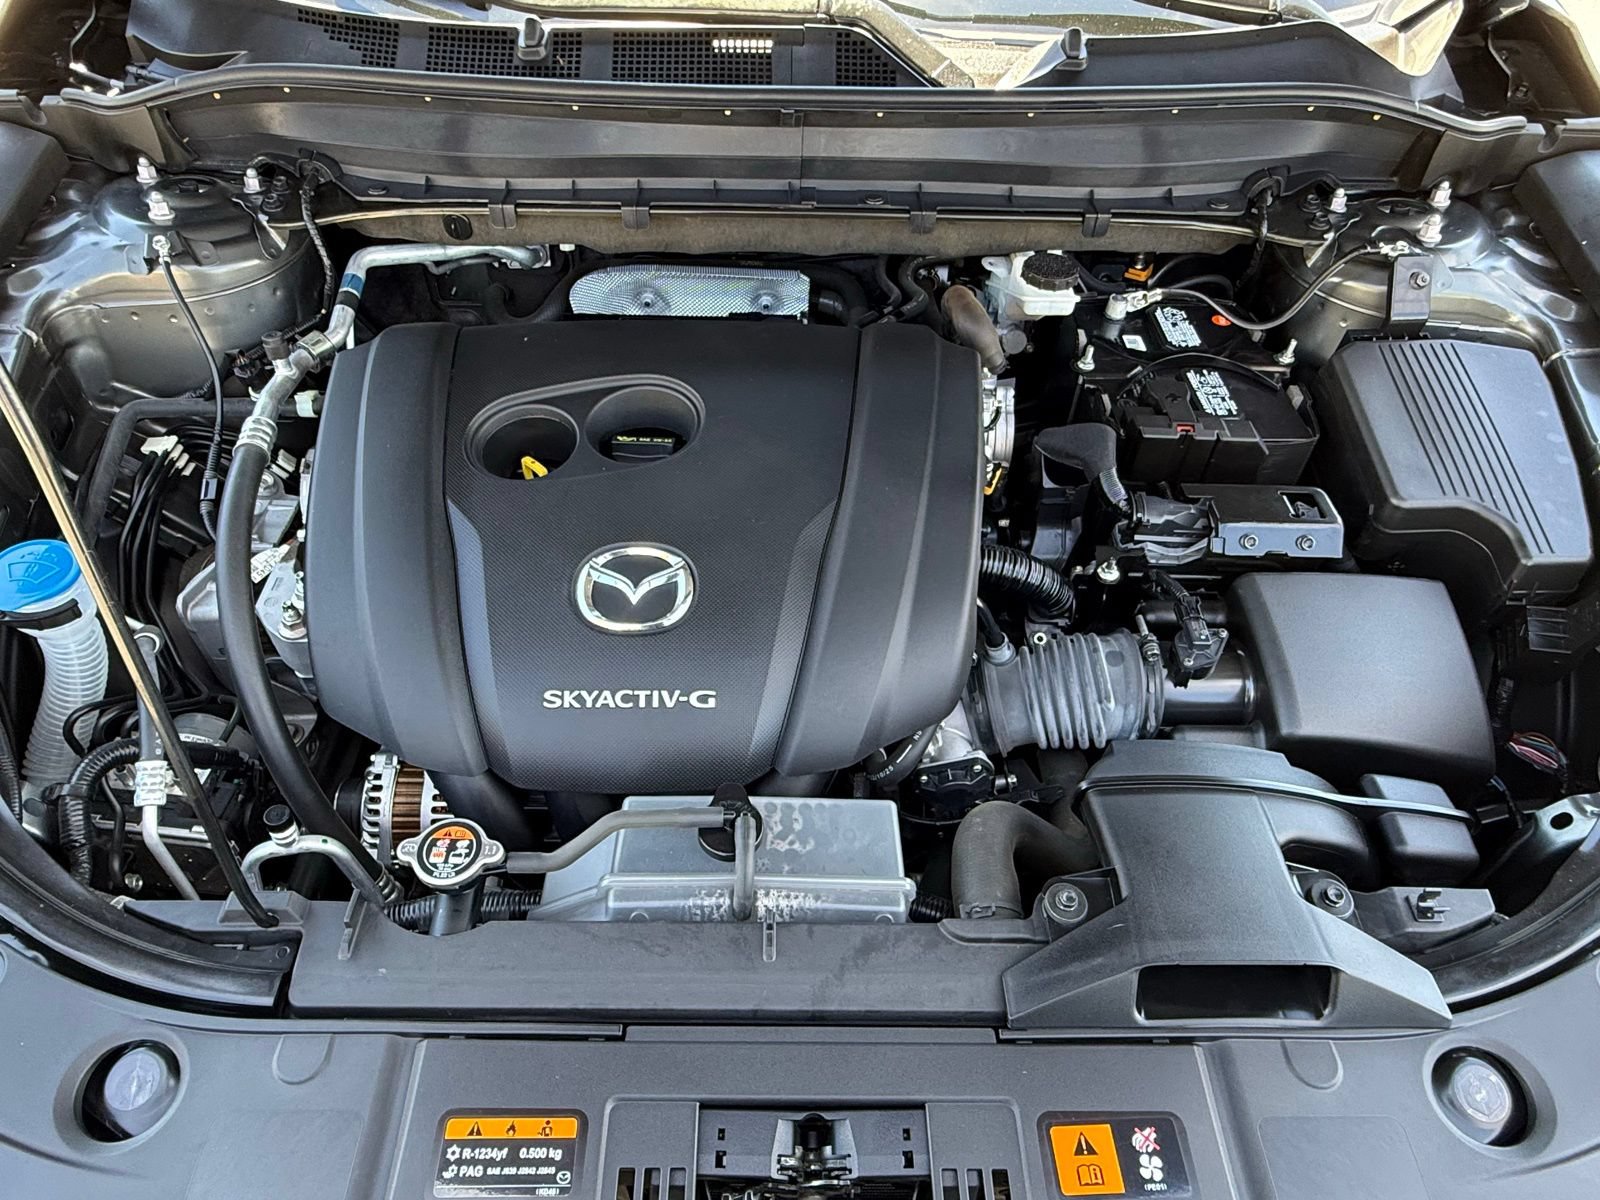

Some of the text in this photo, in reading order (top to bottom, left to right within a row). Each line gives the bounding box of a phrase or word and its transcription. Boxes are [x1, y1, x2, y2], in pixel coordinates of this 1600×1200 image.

[542, 689, 717, 709] SKYACTIV-G
[461, 1147, 563, 1162] R-1234yf 0.500 kg
[459, 1165, 484, 1178] PAG
